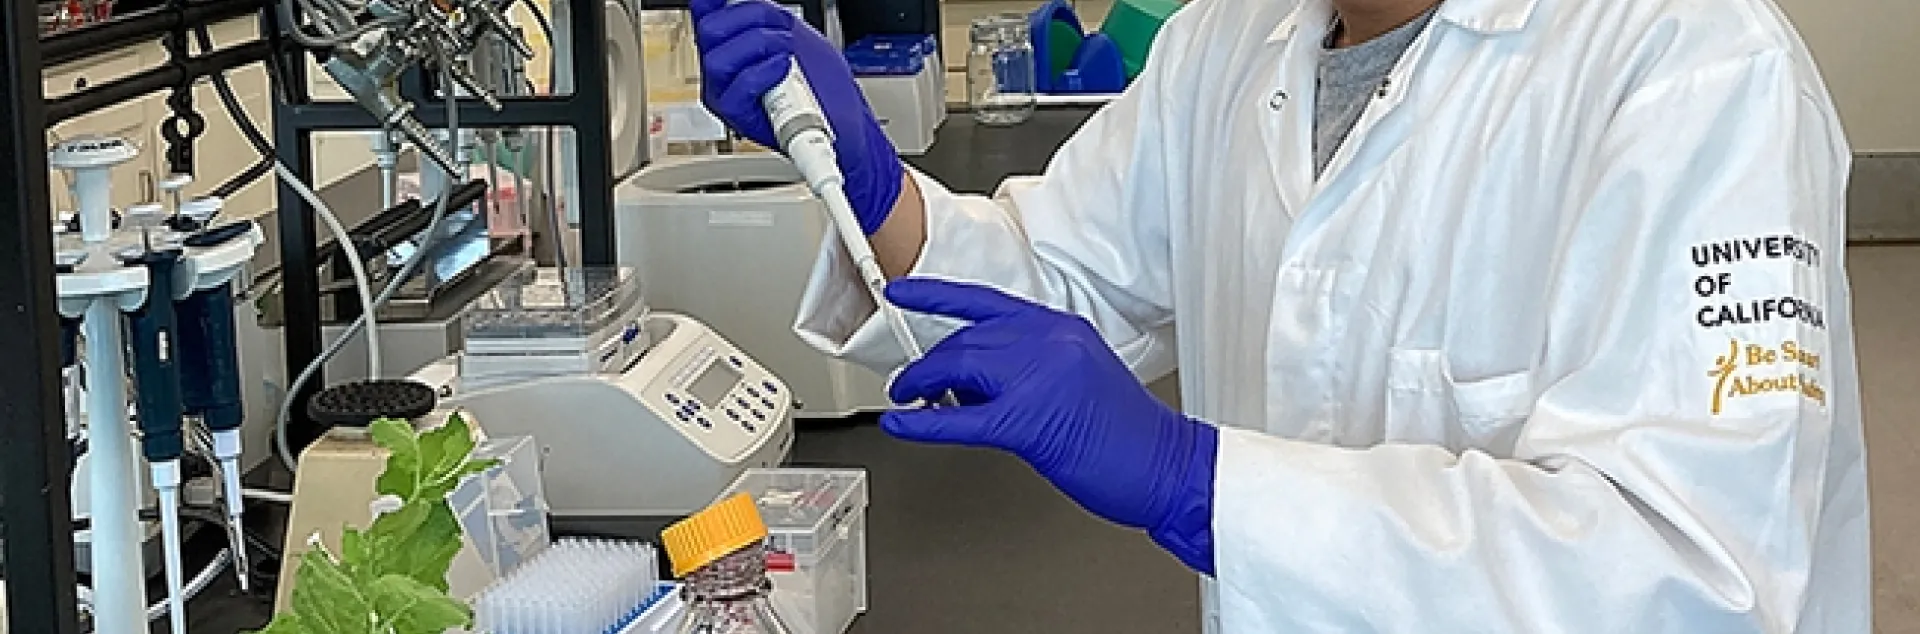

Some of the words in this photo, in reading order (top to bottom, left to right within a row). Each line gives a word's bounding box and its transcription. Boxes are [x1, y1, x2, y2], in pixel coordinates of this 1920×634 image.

[1694, 272, 1732, 297] OF
[1697, 296, 1826, 330] CALIFO
[1745, 344, 1776, 366] Be
[1728, 374, 1798, 397] About
